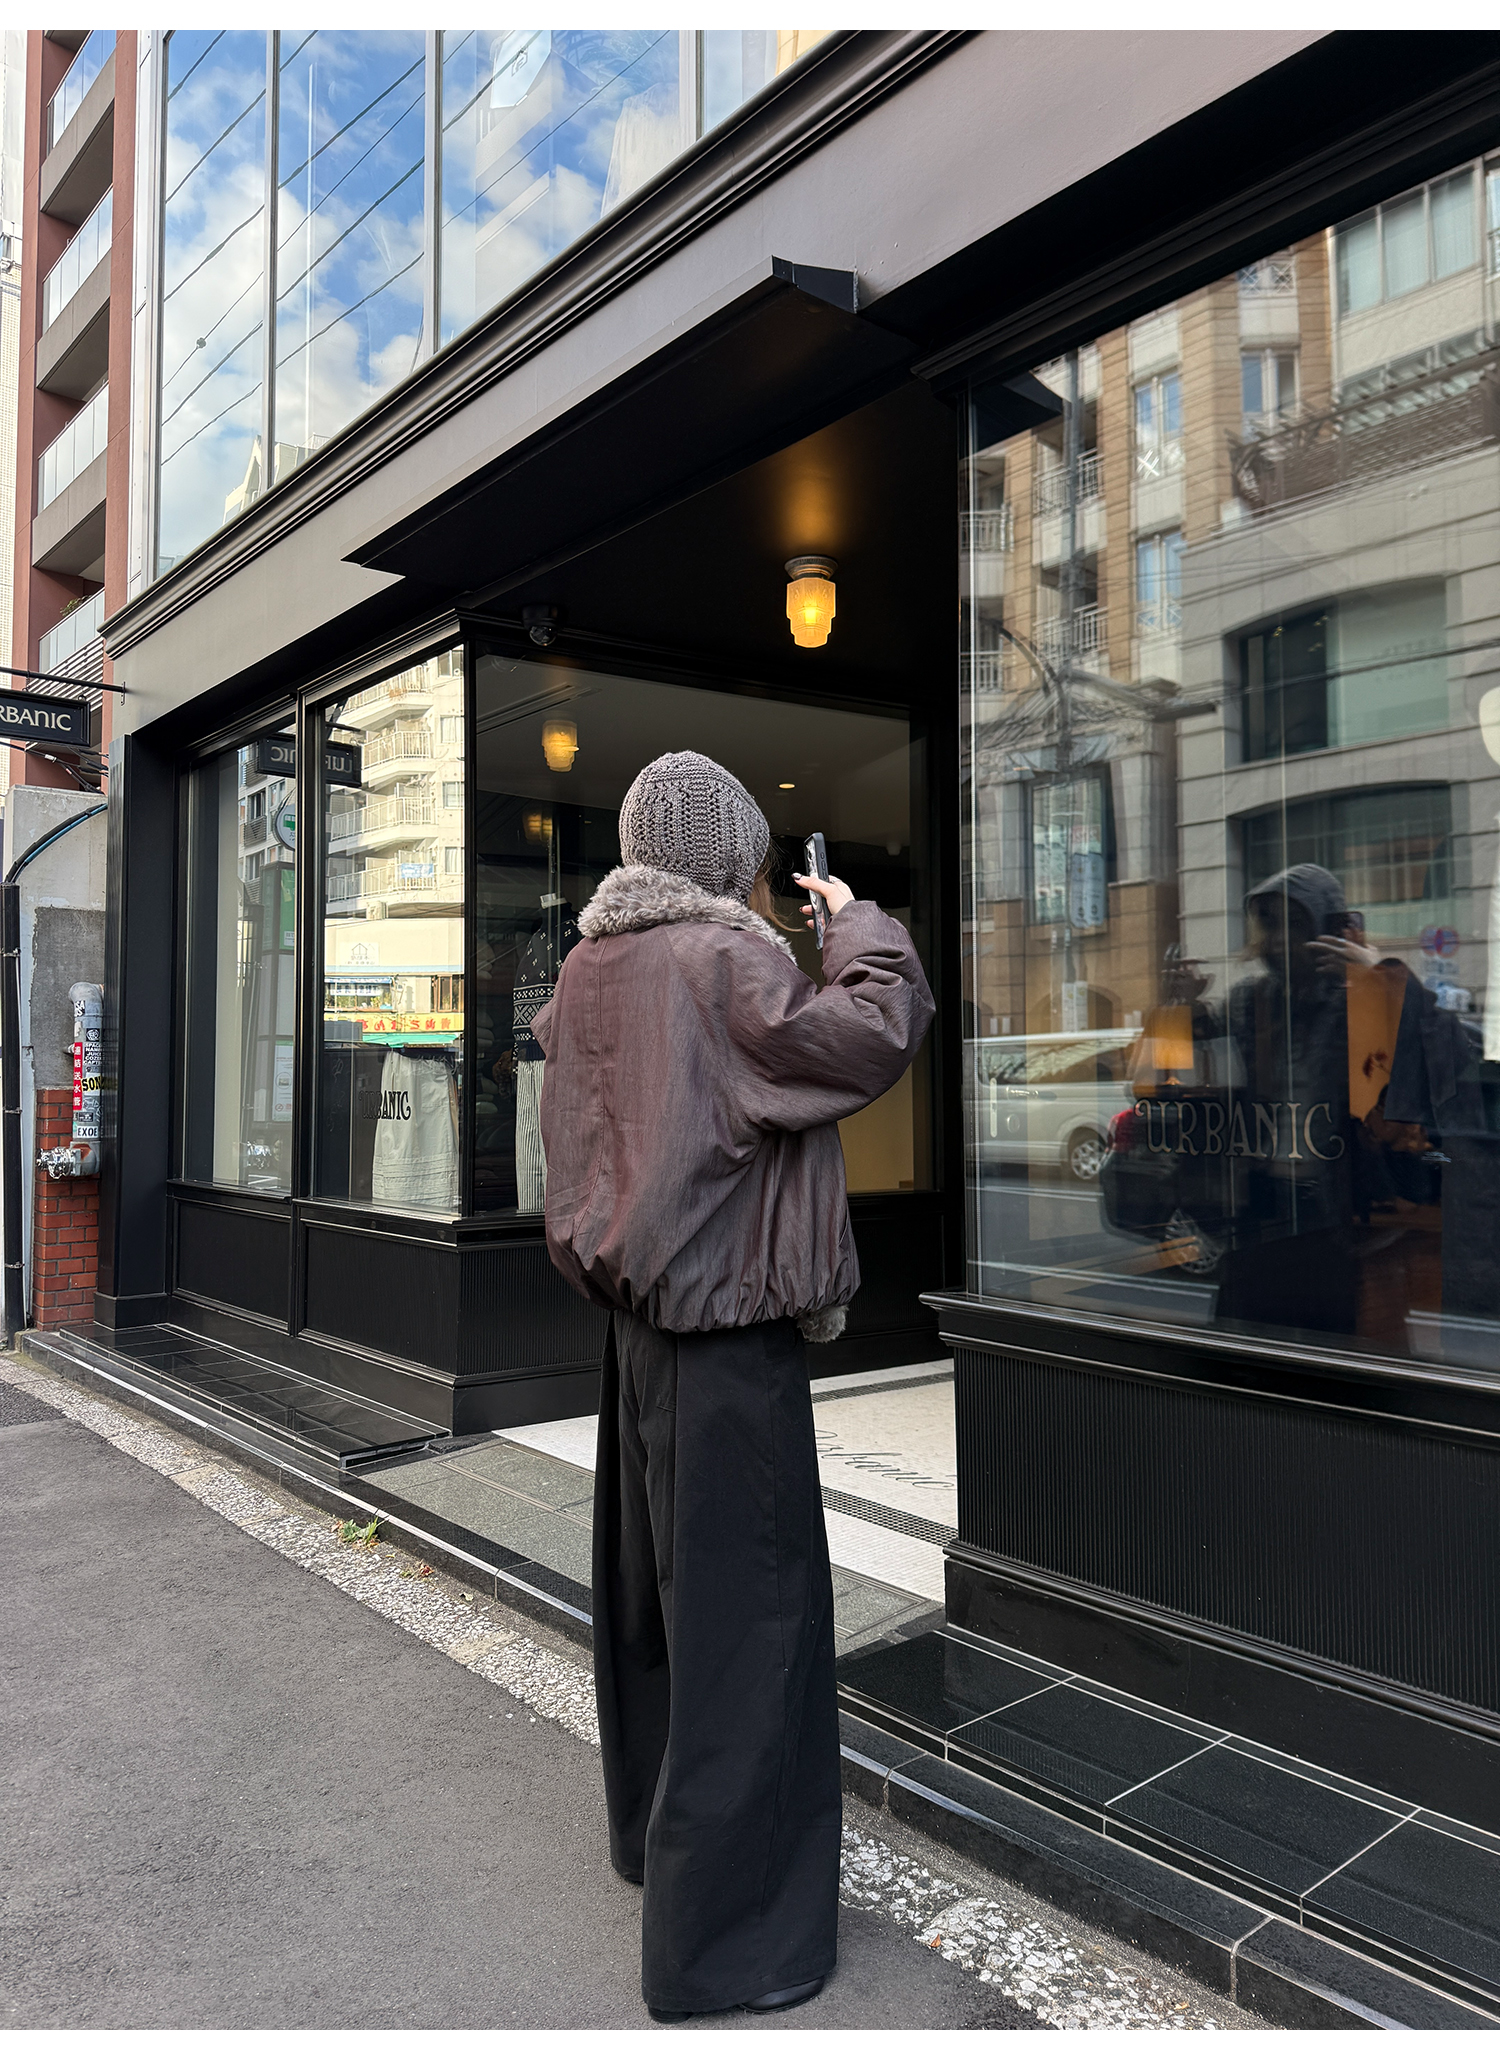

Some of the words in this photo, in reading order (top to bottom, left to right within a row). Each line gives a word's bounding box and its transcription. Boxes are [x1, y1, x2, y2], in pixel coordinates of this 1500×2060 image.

[74, 1046, 82, 1107] 連結送水管
[1134, 1099, 1345, 1160] URBANIC
